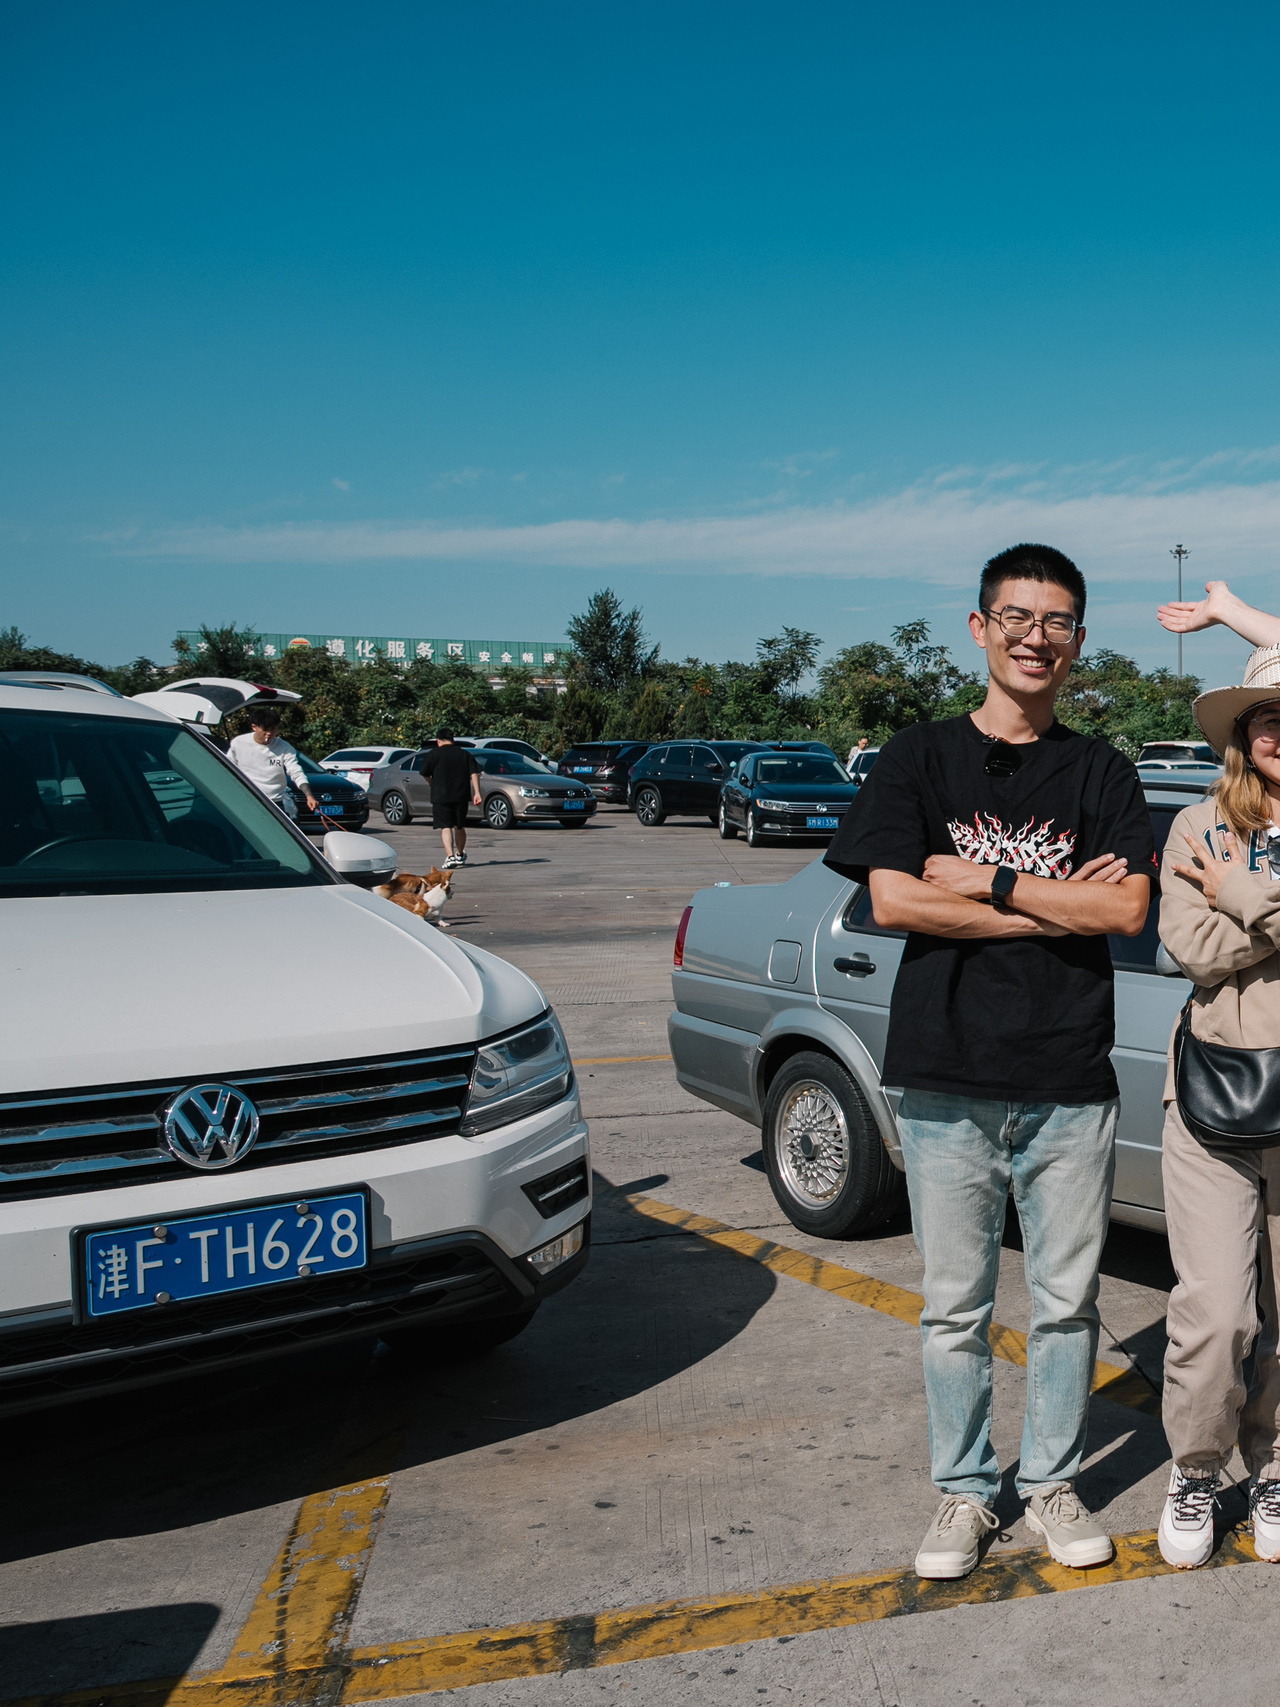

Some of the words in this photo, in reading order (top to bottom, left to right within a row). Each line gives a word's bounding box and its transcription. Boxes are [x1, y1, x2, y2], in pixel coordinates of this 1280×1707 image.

[326, 638, 465, 660] 遵化服务区
[478, 650, 555, 664] 安全畅通
